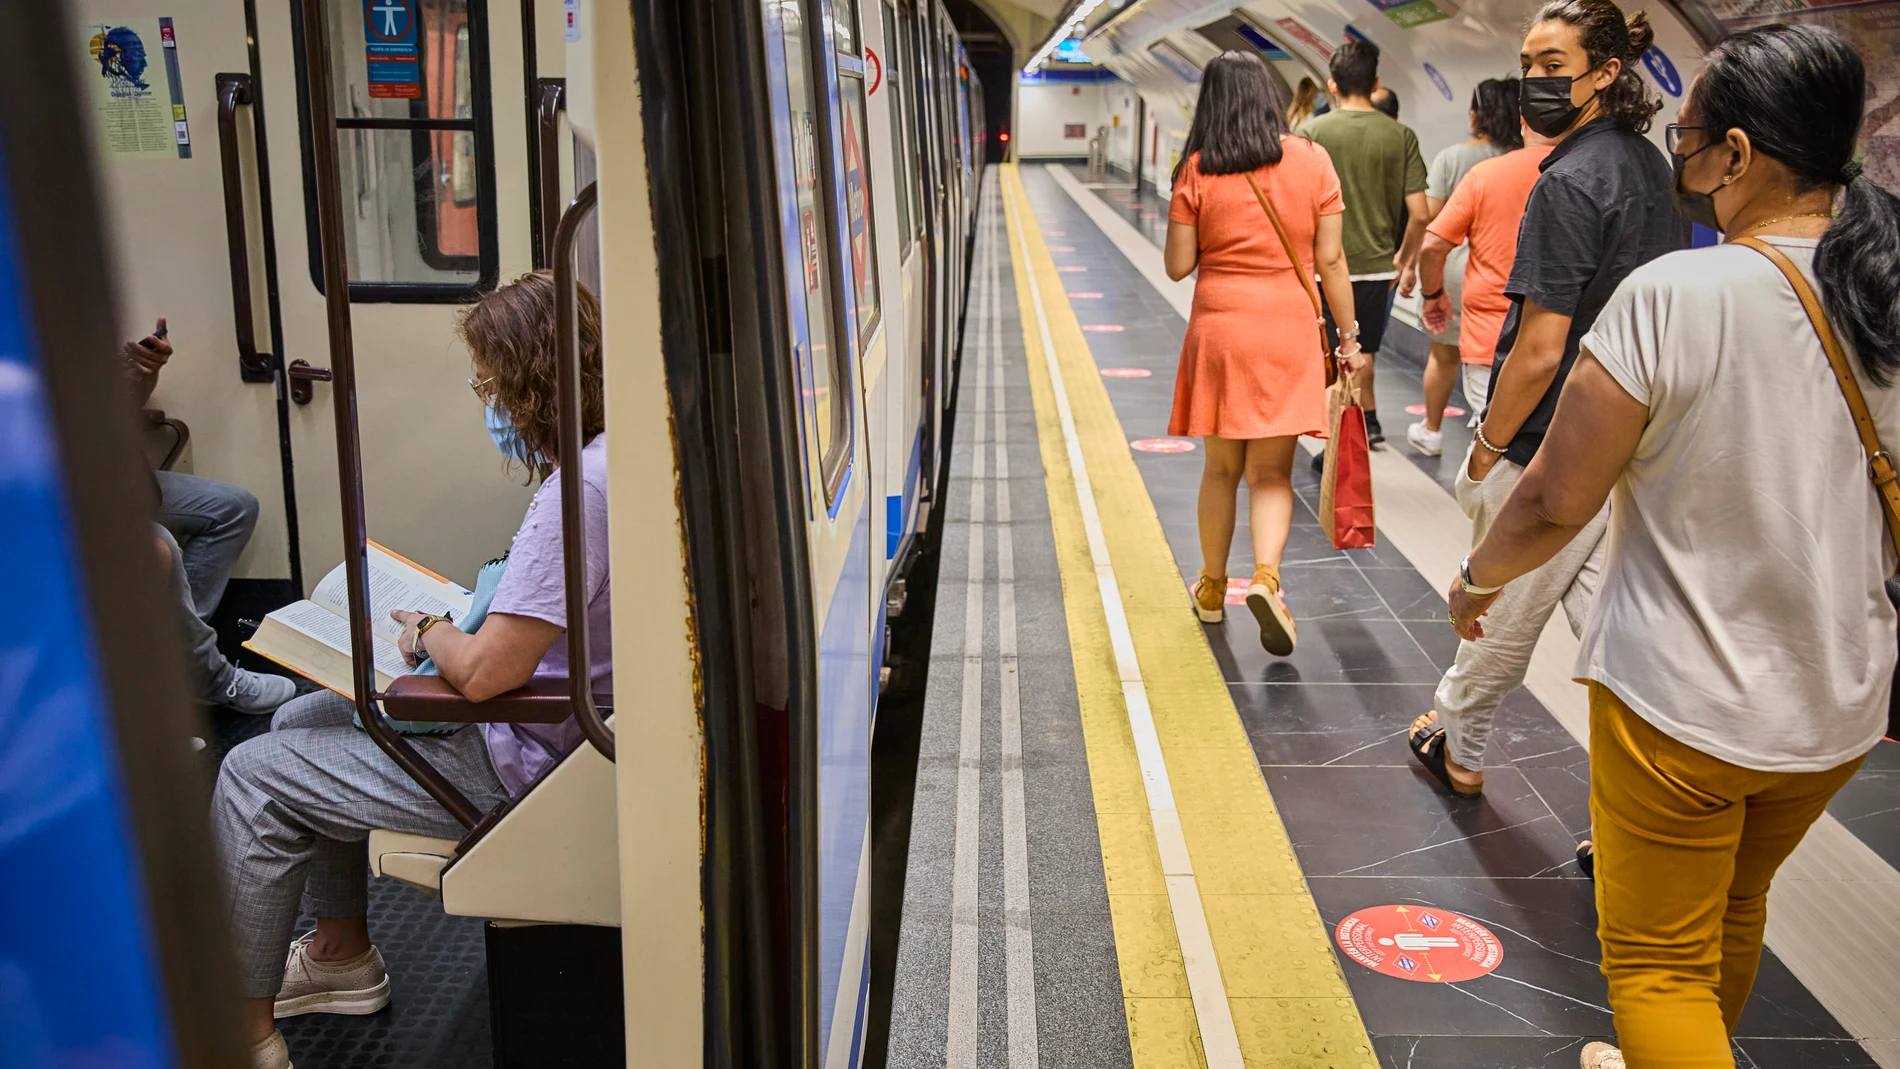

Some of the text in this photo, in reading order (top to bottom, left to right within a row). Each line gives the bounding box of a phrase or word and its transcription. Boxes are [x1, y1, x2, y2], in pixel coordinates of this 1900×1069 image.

[1340, 917, 1360, 940] DISTANCIA
[1352, 922, 1384, 962] INTERPERSONAL
[1451, 922, 1486, 963] INTERPERSONAL
[1455, 918, 1489, 937] MANTÉN
[1480, 944, 1498, 968] DISTANCIA
[1346, 947, 1379, 968] MANTÉN
